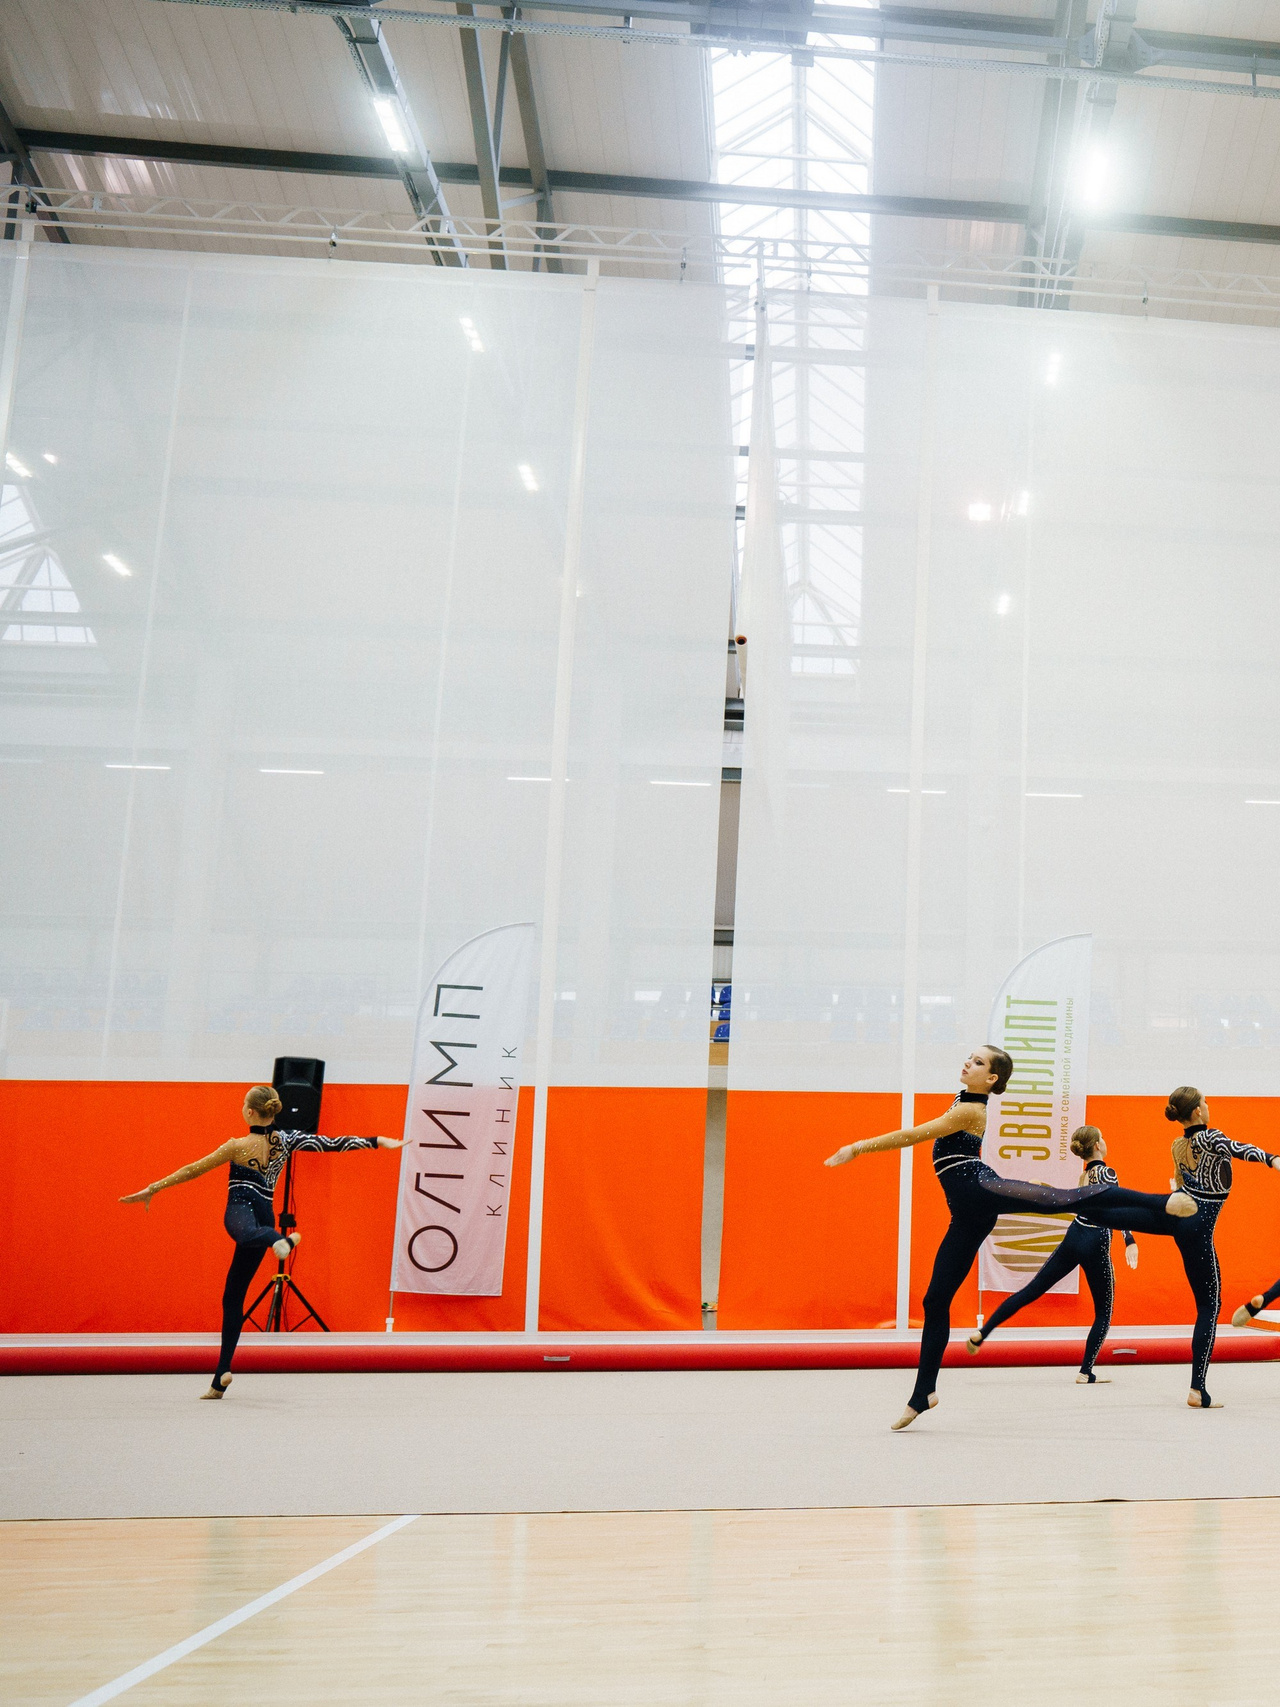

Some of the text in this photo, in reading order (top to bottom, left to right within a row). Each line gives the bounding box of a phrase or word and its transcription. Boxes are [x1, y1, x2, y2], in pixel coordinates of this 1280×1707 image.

[407, 983, 484, 1273] ОЛИМП
[486, 1046, 518, 1217] КЛИНИК
[998, 995, 1058, 1161] ЭВКАЛИПТ
[1058, 997, 1074, 1161] клиника семейной медицины
